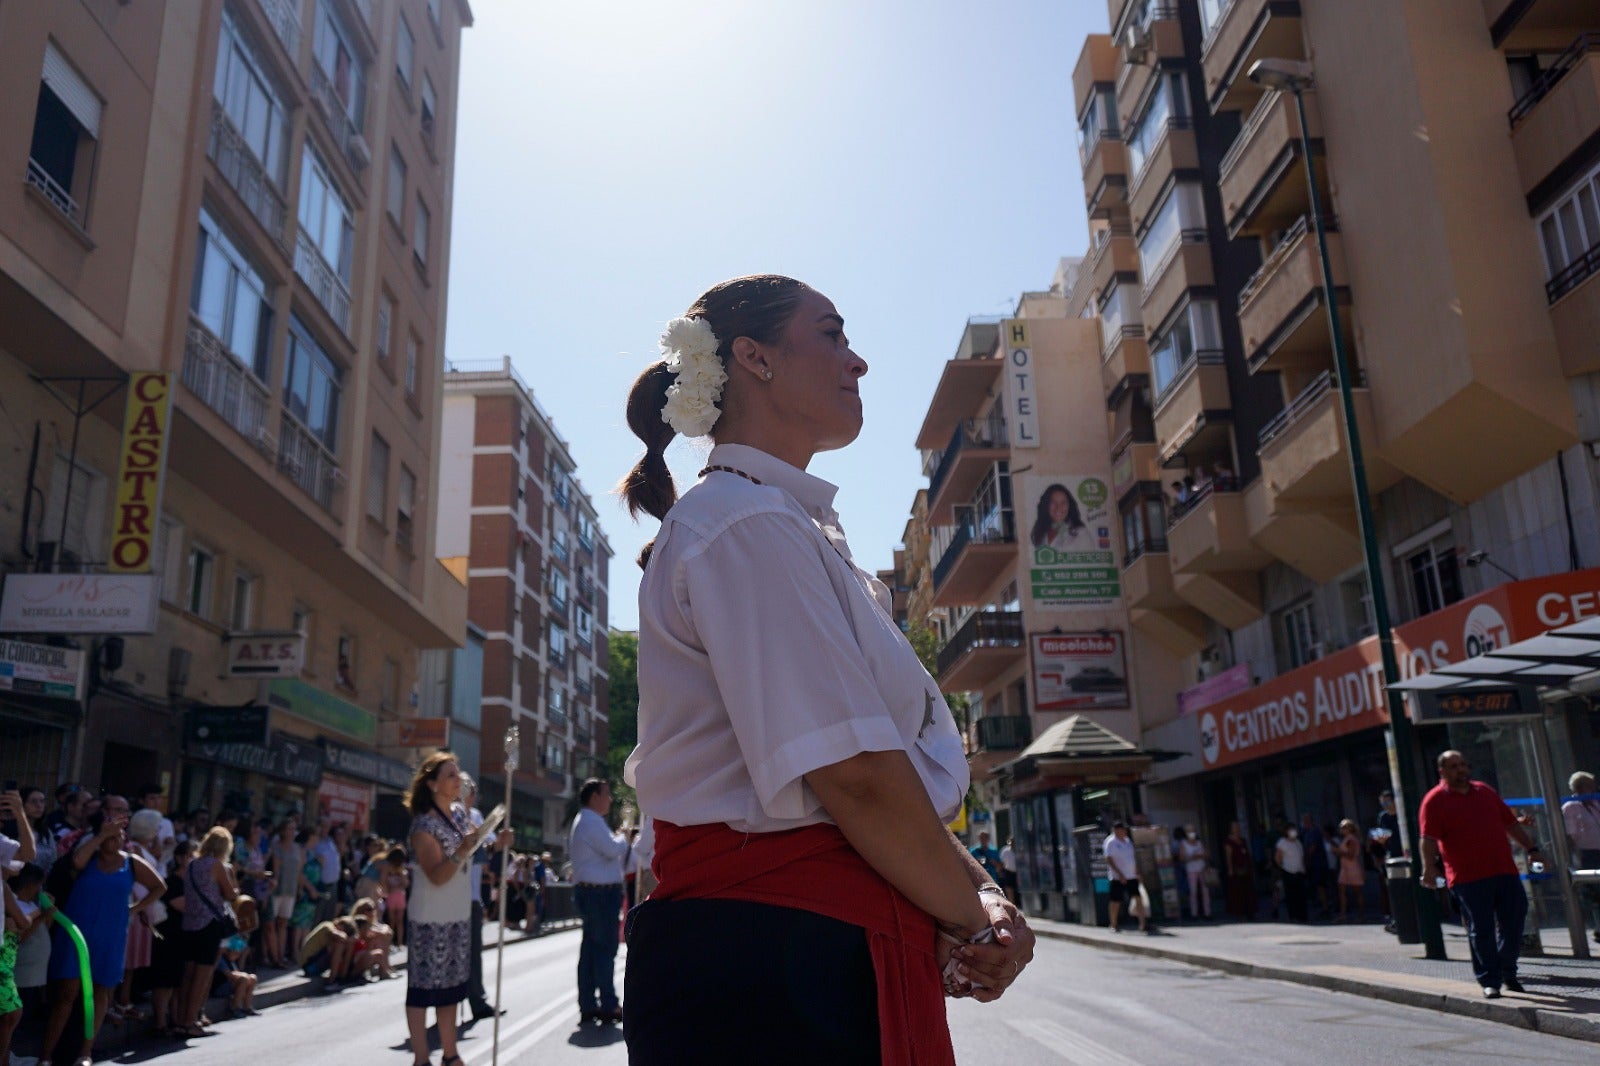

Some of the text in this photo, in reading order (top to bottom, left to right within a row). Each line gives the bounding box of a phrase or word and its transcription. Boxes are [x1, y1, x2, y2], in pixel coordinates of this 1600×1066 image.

[1012, 325, 1033, 440] HOTEL
[112, 374, 167, 569] CASTRO
[1536, 592, 1600, 627] CE
[236, 643, 296, 660] A.T.S.
[1223, 690, 1309, 753] CENTROS
